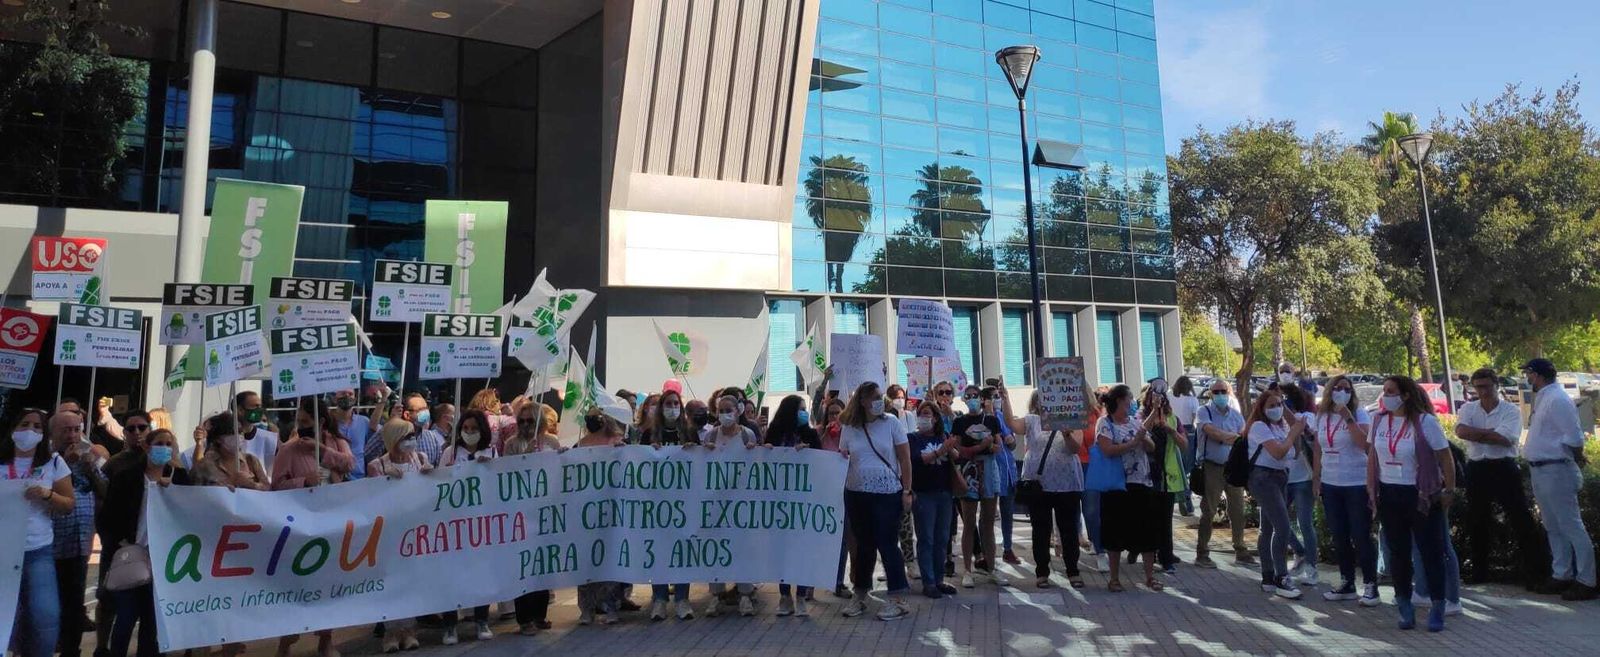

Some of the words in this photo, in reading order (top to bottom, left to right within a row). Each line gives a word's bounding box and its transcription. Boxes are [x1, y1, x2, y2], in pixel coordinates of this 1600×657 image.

[38, 240, 103, 268] USO
[384, 262, 446, 284] FSIE
[174, 285, 246, 305] FSIE
[280, 279, 345, 300] FSIE
[69, 305, 134, 329] FSIE
[212, 308, 257, 338] FSIE
[434, 315, 495, 336] FSIE
[281, 325, 349, 352] FSIE
[60, 353, 76, 361] FSIE
[278, 384, 296, 393] FSIE
[433, 476, 483, 512] POR
[497, 468, 548, 502] UNA
[560, 455, 693, 493] EDUCACIÓN
[705, 460, 813, 492] INFANTIL
[399, 511, 526, 558] GRATUITA
[537, 505, 567, 536] EN
[582, 498, 687, 530] CENTROS
[700, 500, 838, 535] EXCLUSIVOS
[519, 543, 578, 580] PARA
[618, 540, 630, 568] A
[643, 542, 655, 568] 3
[669, 534, 733, 568] AÑOS
[159, 594, 232, 617] scuelas
[330, 577, 385, 597] Unidas
